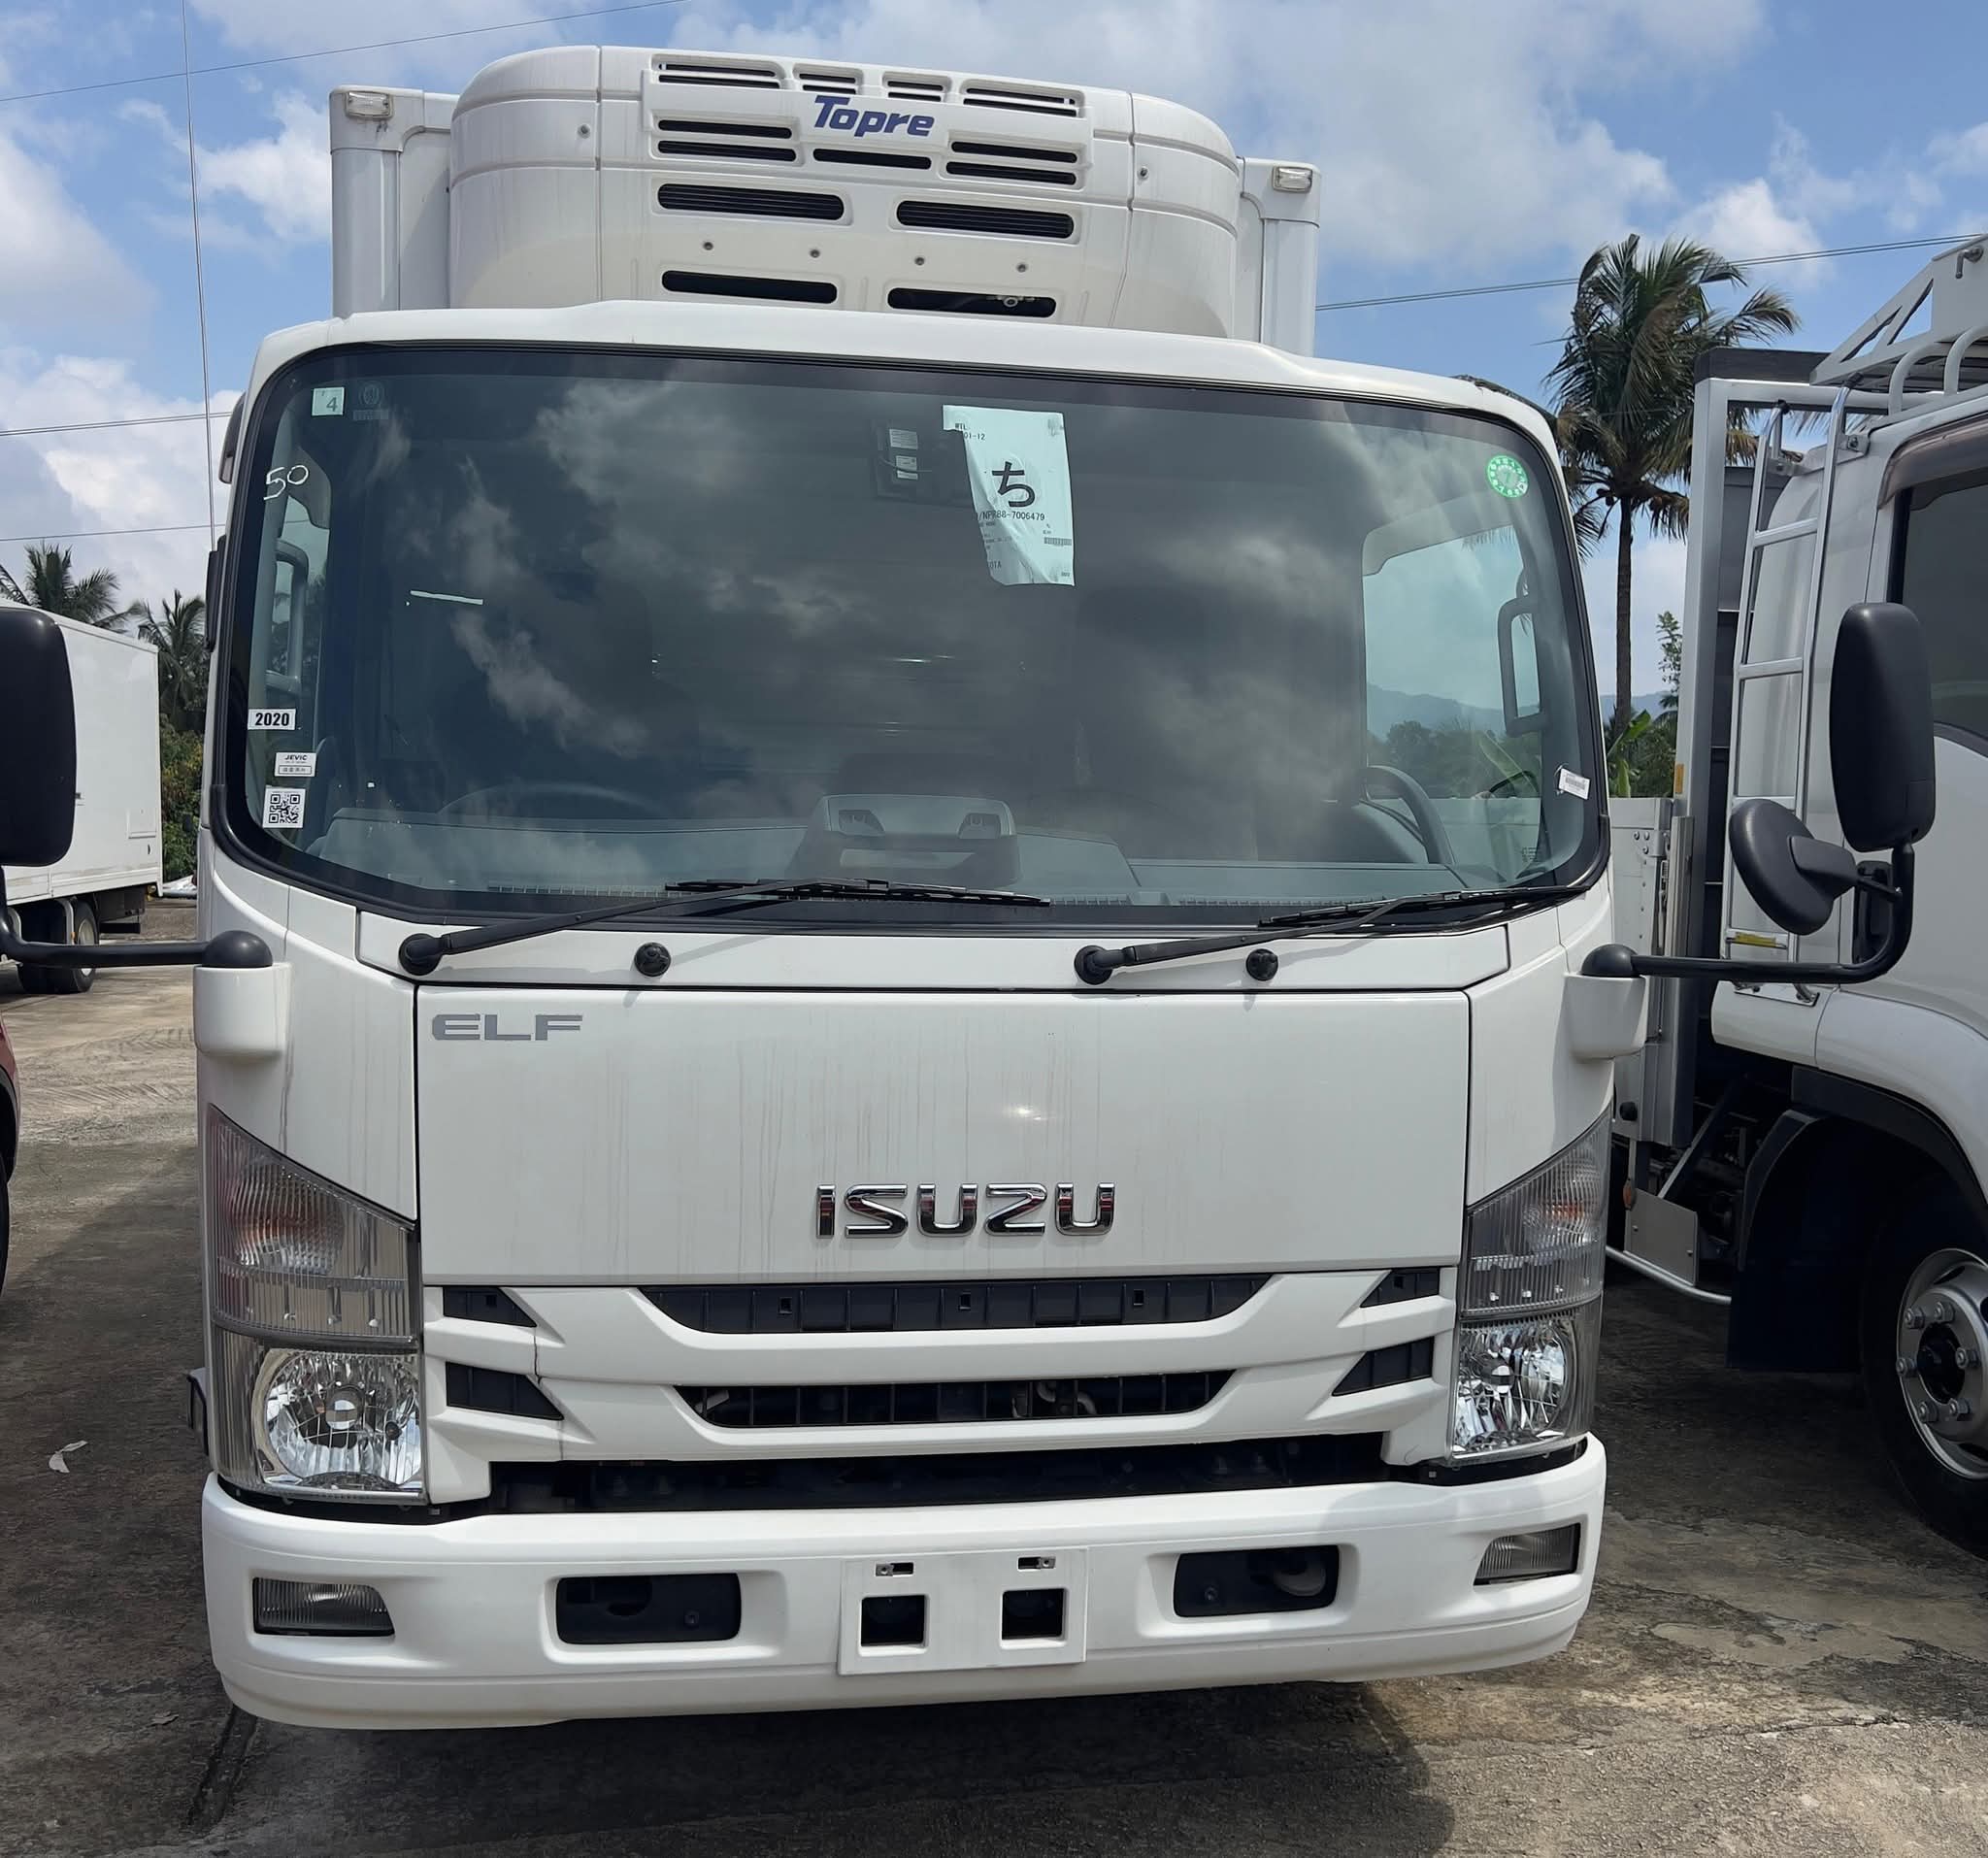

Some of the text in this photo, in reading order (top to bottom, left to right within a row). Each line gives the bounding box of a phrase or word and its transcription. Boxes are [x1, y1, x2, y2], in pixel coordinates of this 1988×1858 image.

[813, 94, 935, 138] Topre
[326, 397, 338, 413] 4
[263, 465, 309, 500] 50
[991, 461, 1036, 508] ち
[254, 713, 290, 726] 2020
[431, 1013, 582, 1041] ELF
[815, 1182, 1116, 1238] ISUZU
